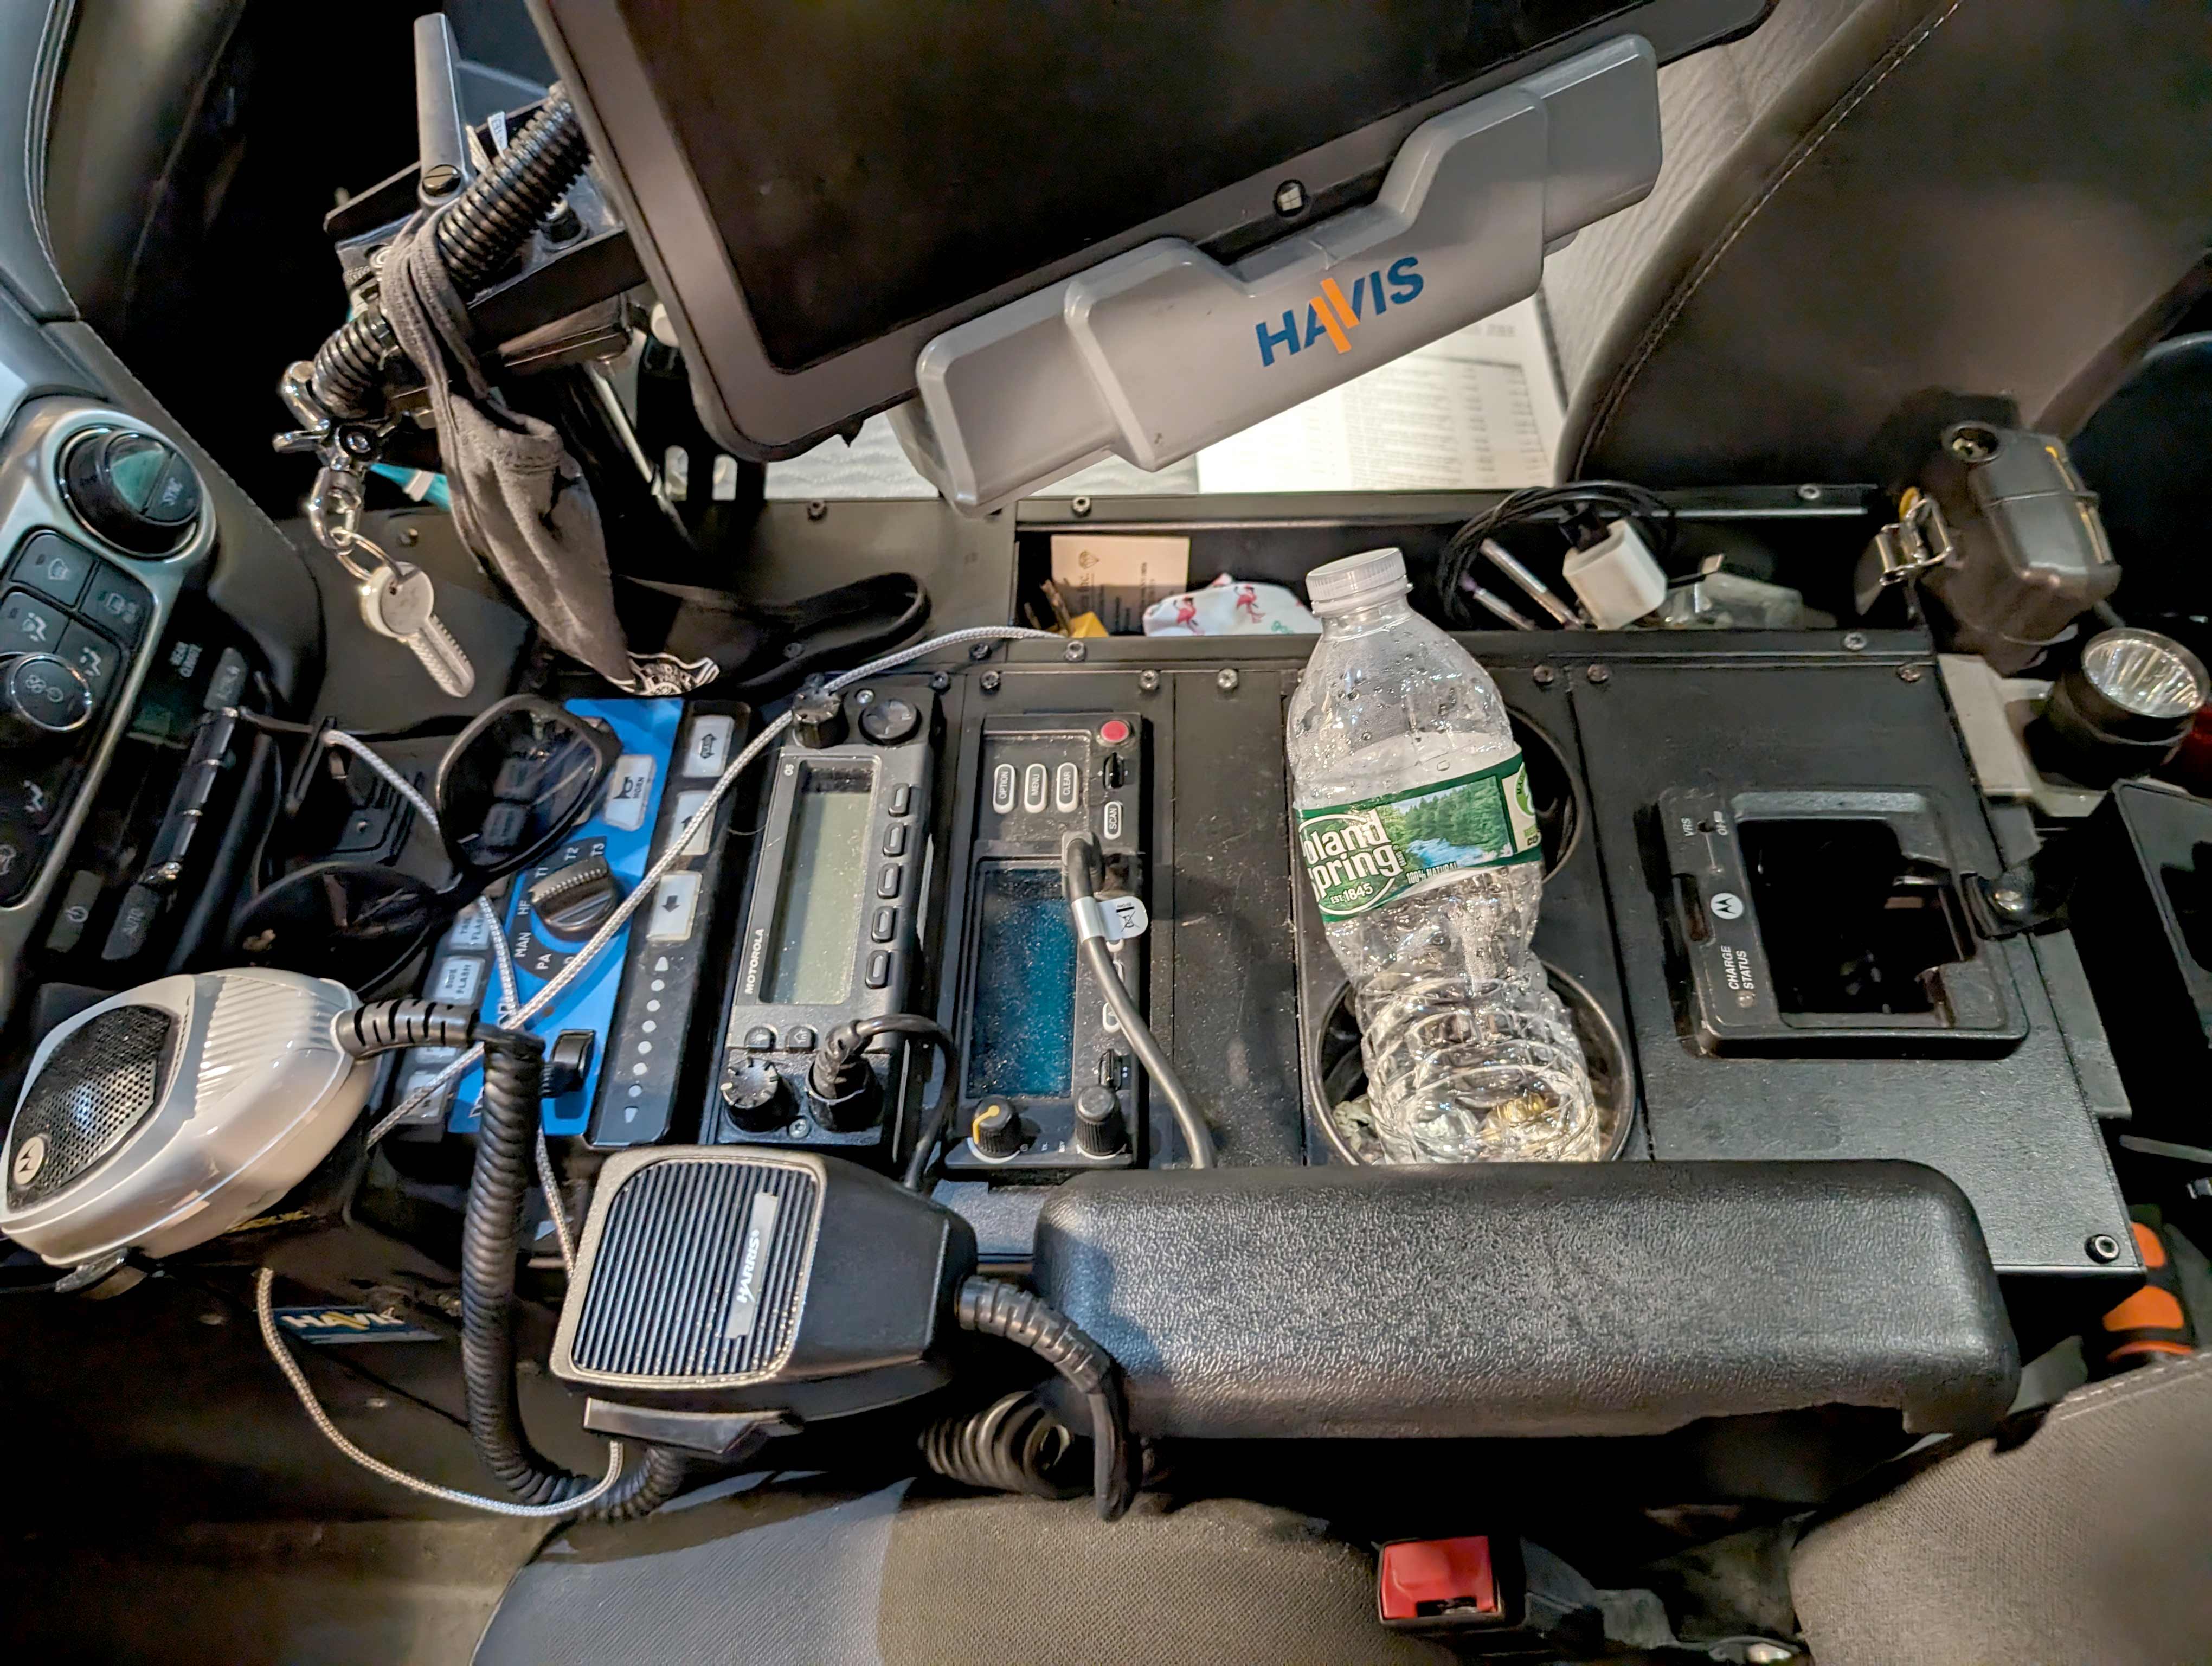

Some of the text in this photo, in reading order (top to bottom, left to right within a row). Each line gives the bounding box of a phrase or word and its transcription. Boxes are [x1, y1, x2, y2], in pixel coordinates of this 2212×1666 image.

[1255, 256, 1424, 368] HAVIS
[632, 777, 644, 799] HORN
[999, 771, 1009, 799] OPTION
[1031, 774, 1040, 796] MENU
[1063, 771, 1071, 796] CLEAR
[1109, 808, 1117, 829] SCAN
[1681, 819, 1694, 836] VRS
[1300, 808, 1391, 865] oland
[564, 847, 579, 861] T2
[590, 843, 605, 856] T3
[1307, 844, 1403, 903] pring
[1406, 870, 1426, 885] 100%
[1330, 883, 1374, 904] EST. 1845
[517, 900, 530, 915] HF
[515, 932, 531, 957] MAN
[535, 953, 552, 970] PA
[744, 928, 764, 994] MOTOROLA
[1720, 945, 1740, 990] CHARGE
[1736, 951, 1754, 990] STATUS
[456, 964, 472, 994] FLASH
[737, 1234, 760, 1303] HARRIS
